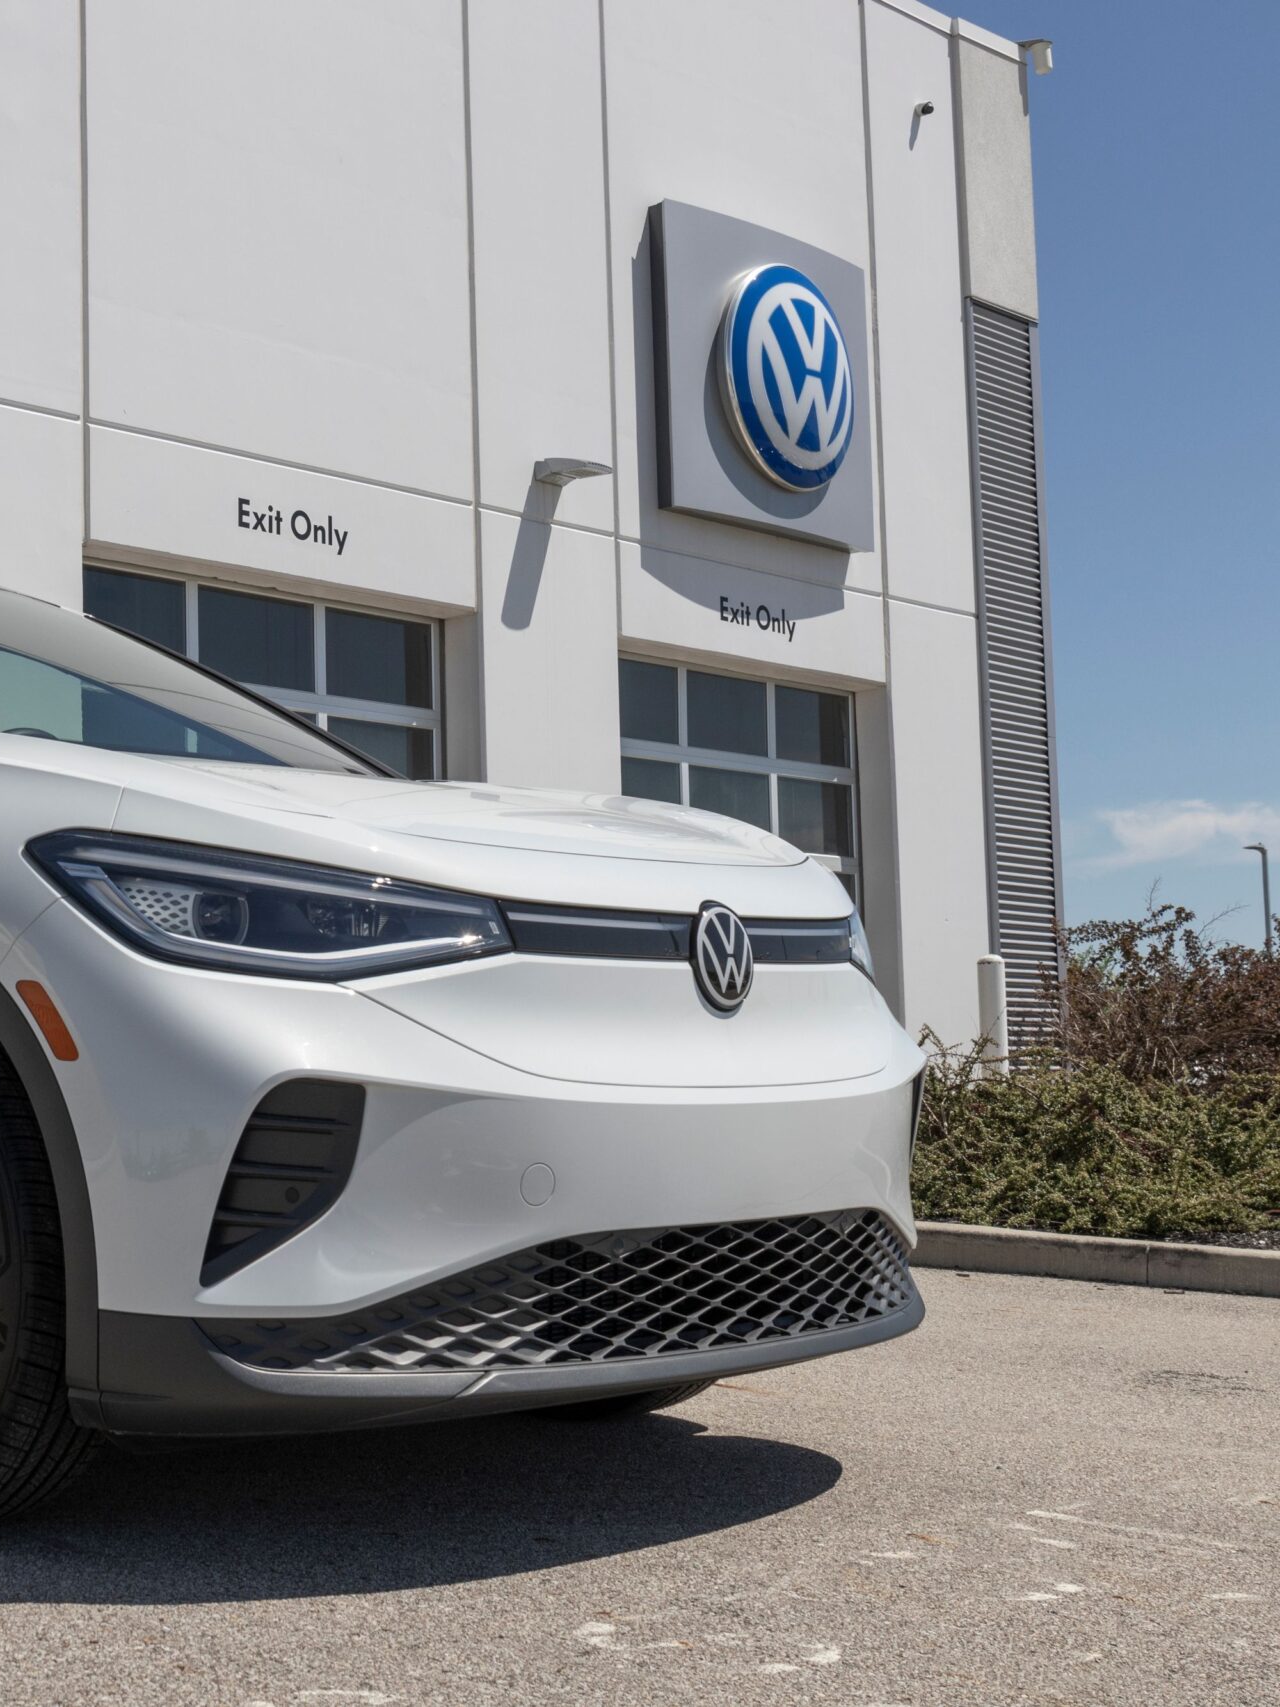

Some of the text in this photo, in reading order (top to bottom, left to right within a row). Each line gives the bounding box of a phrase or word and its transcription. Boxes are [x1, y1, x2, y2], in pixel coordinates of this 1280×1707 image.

[745, 279, 853, 473] VW
[238, 497, 348, 555] Exit Only
[720, 596, 796, 642] Exit Only
[697, 906, 754, 1007] VW
